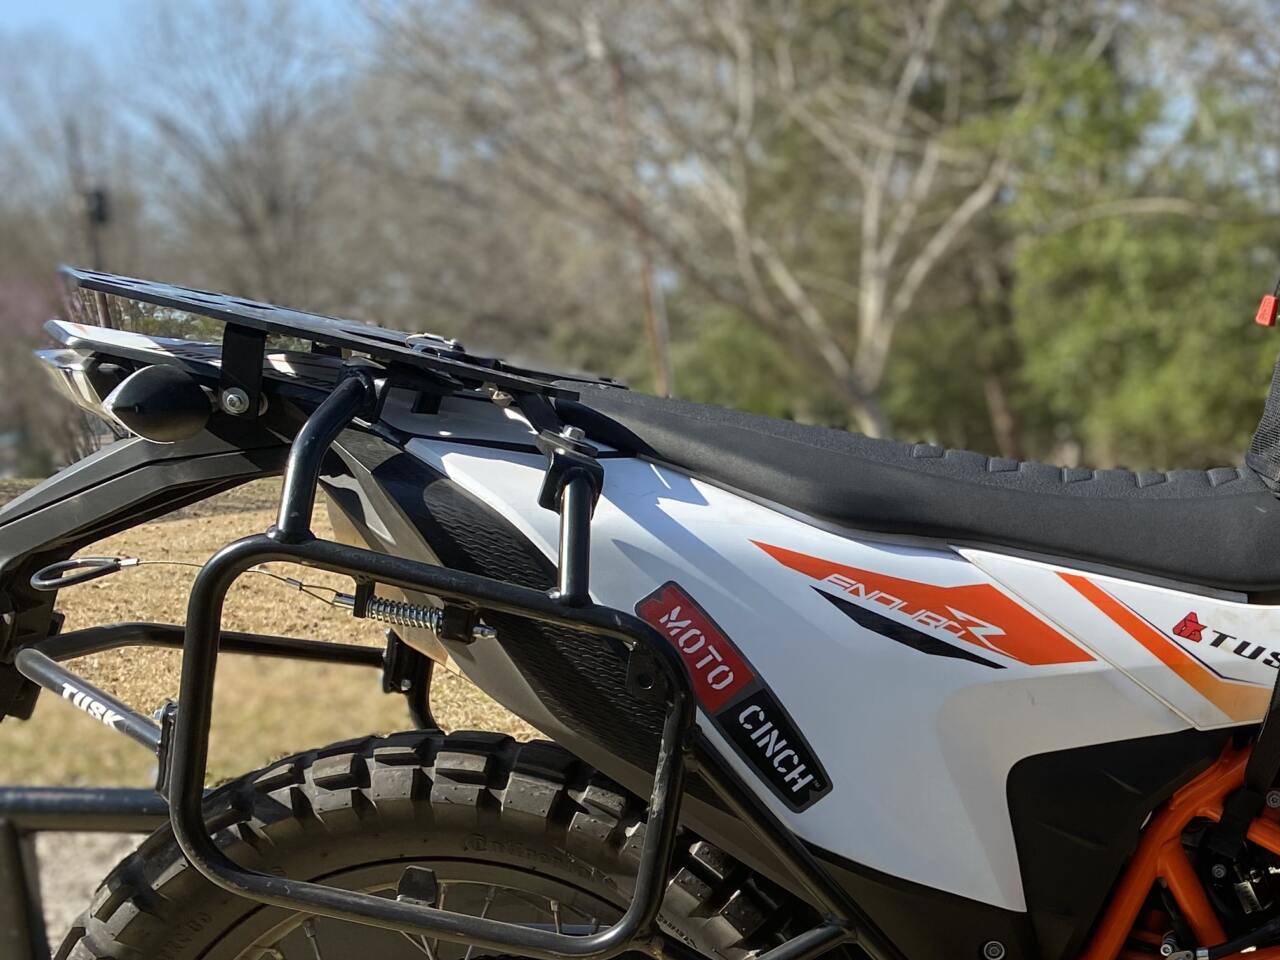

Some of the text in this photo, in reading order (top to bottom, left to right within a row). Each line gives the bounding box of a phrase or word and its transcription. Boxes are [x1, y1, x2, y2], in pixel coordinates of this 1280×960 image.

[58, 682, 127, 729] TUSK
[659, 602, 816, 796] MOTO CINCH
